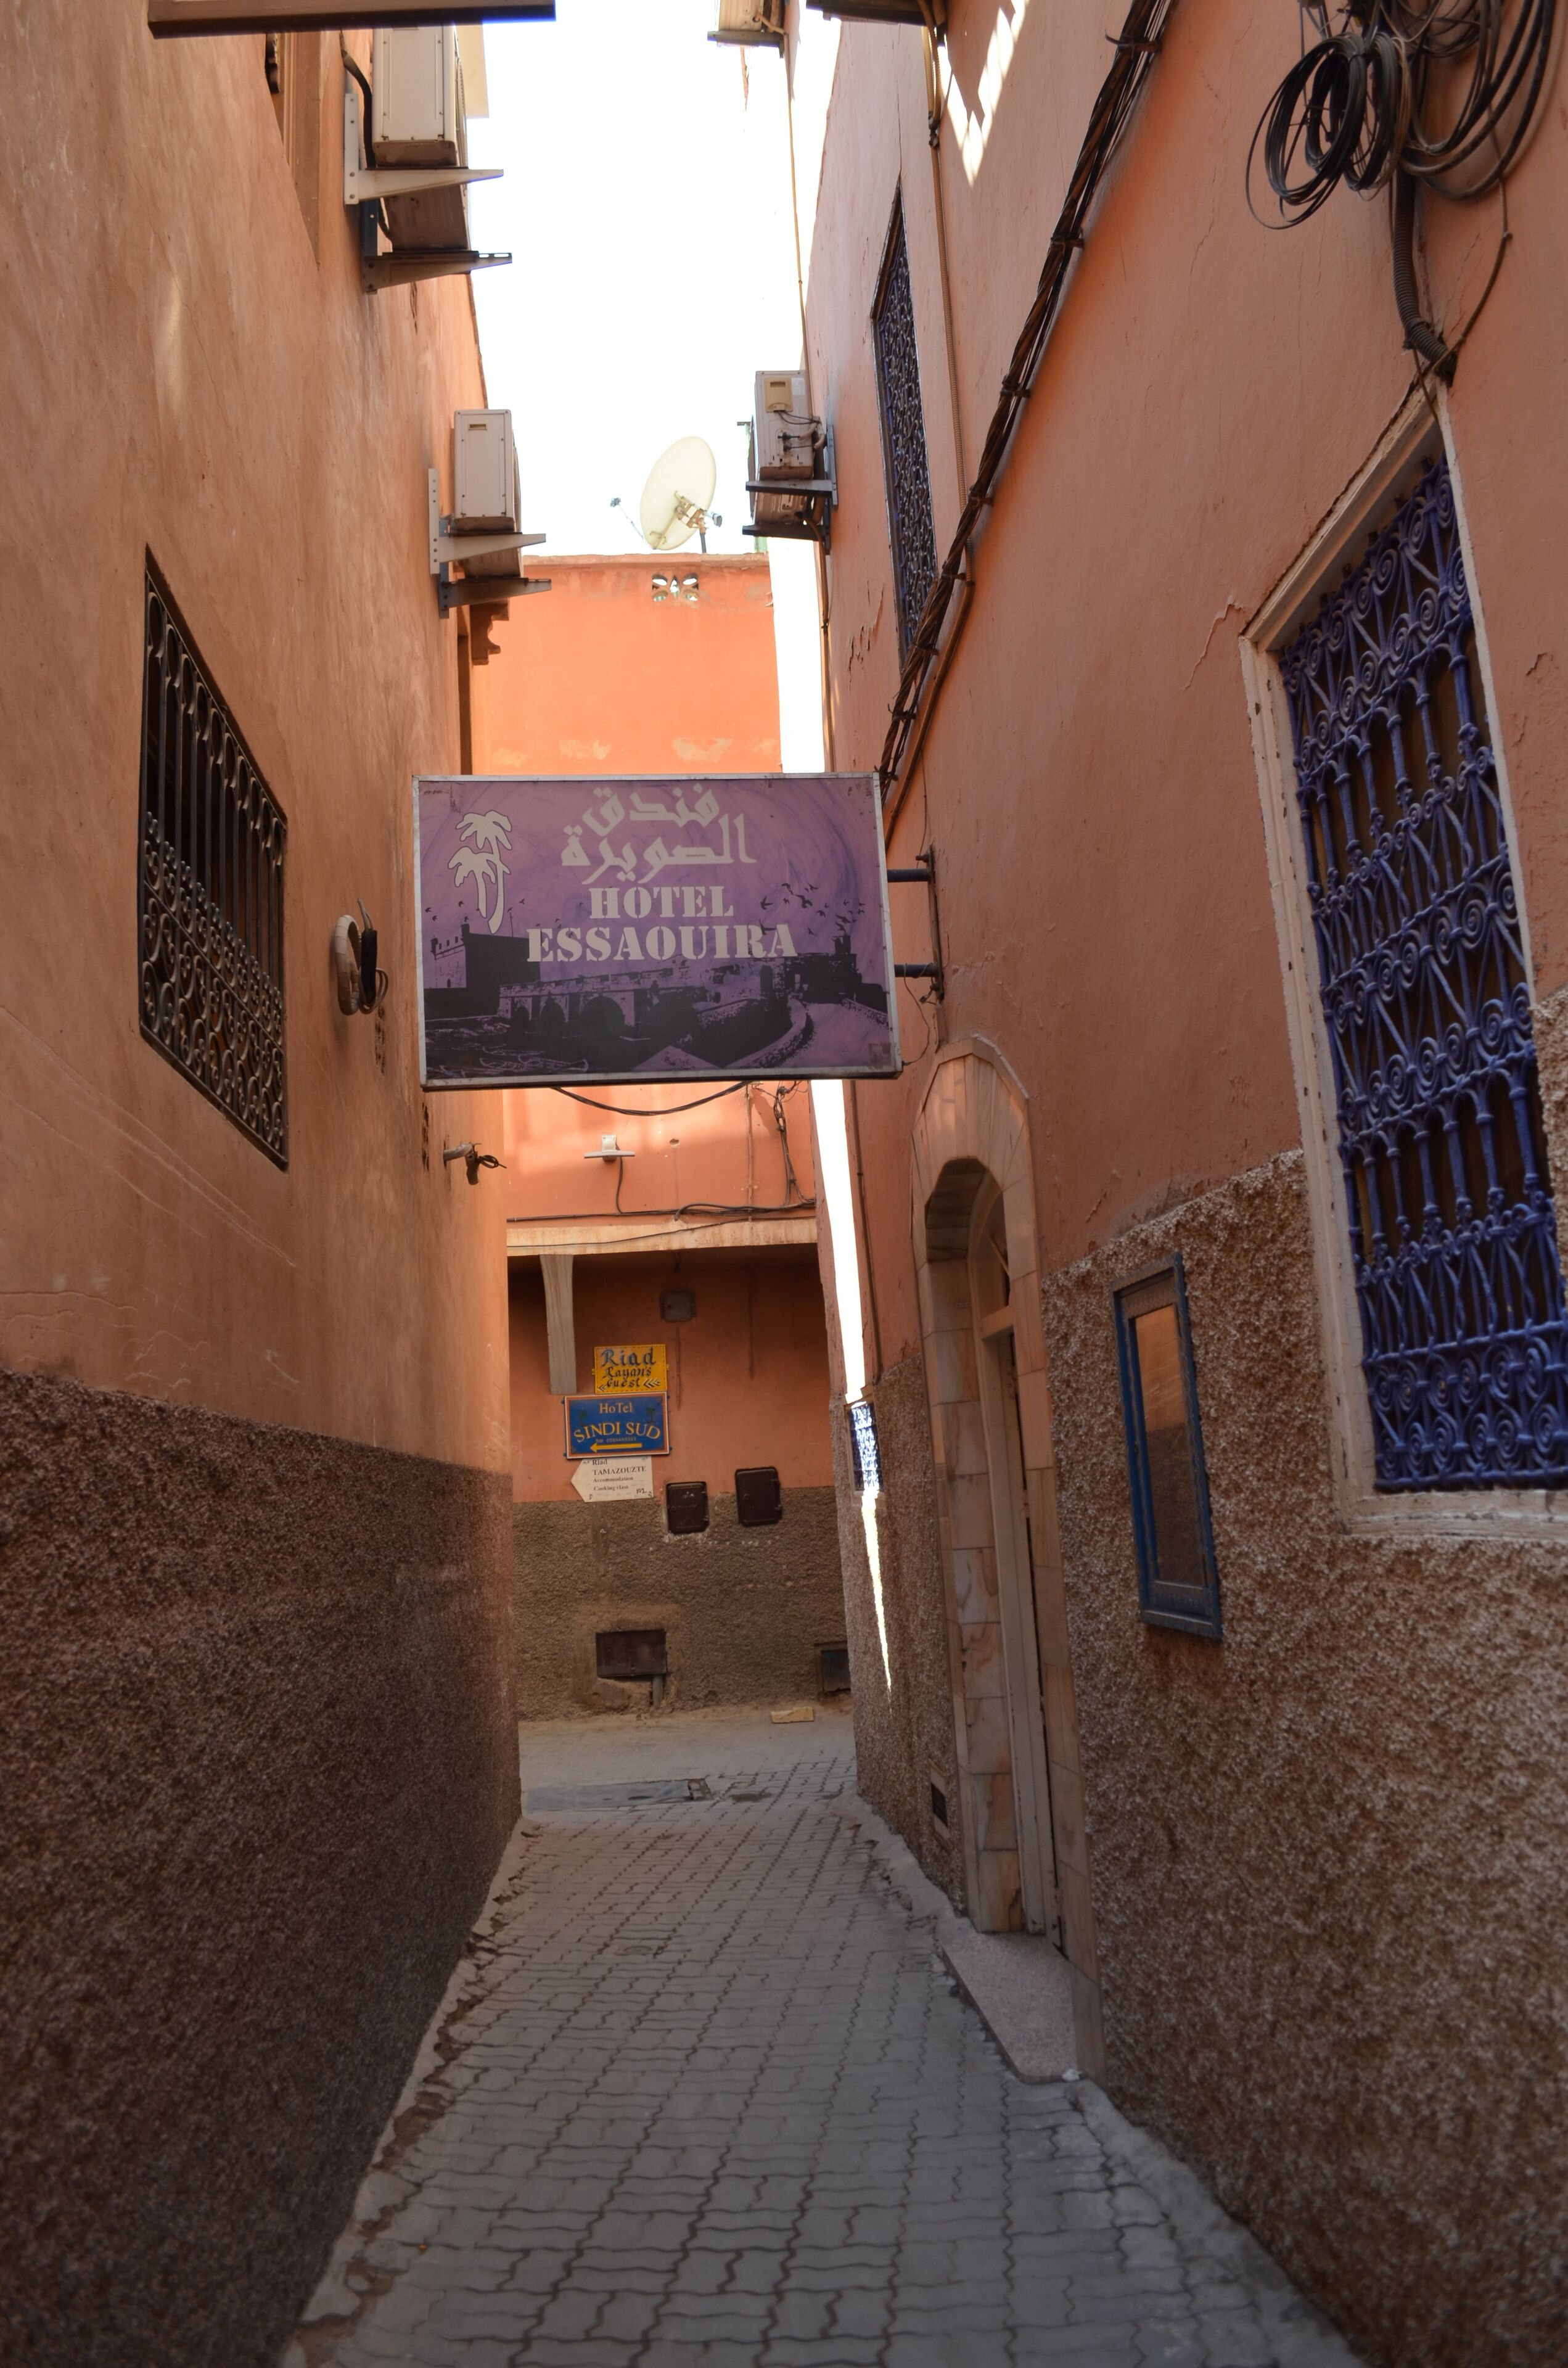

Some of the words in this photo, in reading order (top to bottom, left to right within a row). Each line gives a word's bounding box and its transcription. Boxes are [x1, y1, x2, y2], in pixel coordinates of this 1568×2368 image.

[581, 784, 720, 836] فندق
[560, 813, 757, 885] الصويرة
[589, 886, 734, 919] HOTEL
[525, 923, 798, 963] ESSAOUIRA
[601, 1347, 656, 1367] Riad
[573, 1422, 620, 1442] SINDI
[625, 1421, 661, 1439] SUD
[592, 1466, 646, 1476] TAMAZOUZTE
